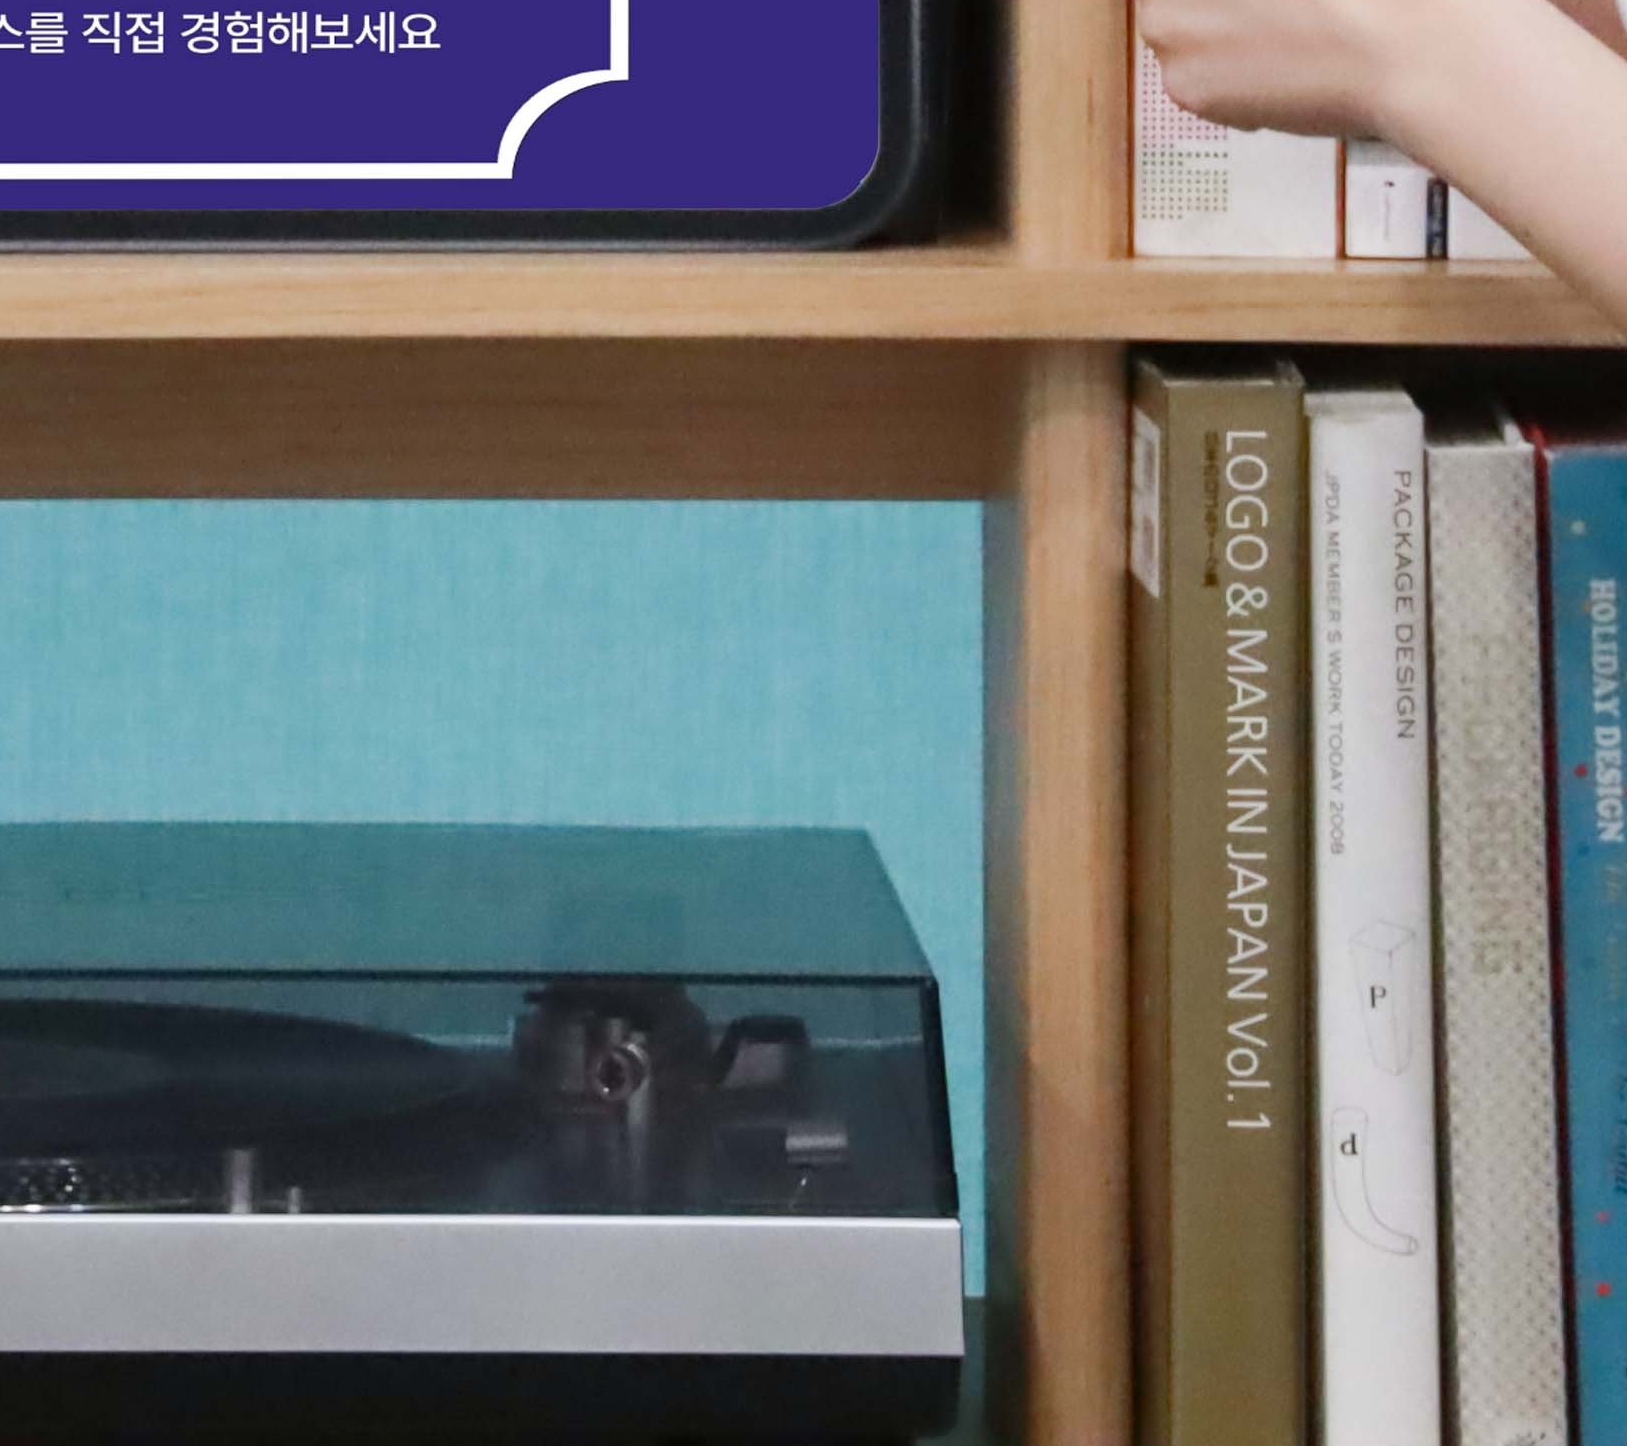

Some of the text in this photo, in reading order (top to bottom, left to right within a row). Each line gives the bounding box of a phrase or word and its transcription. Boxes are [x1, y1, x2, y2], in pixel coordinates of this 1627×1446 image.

[83, 12, 163, 53] 직접
[181, 11, 441, 53] 경험해보세요
[1327, 651, 1344, 714] WORK
[1393, 469, 1417, 740] PACKAGE DESIGN
[1224, 431, 1272, 1131] LOGO & MARK IN JAPAN Vol. 1
[1327, 721, 1344, 793] TODAY
[1589, 579, 1626, 843] HOLIDAY DESIGN
